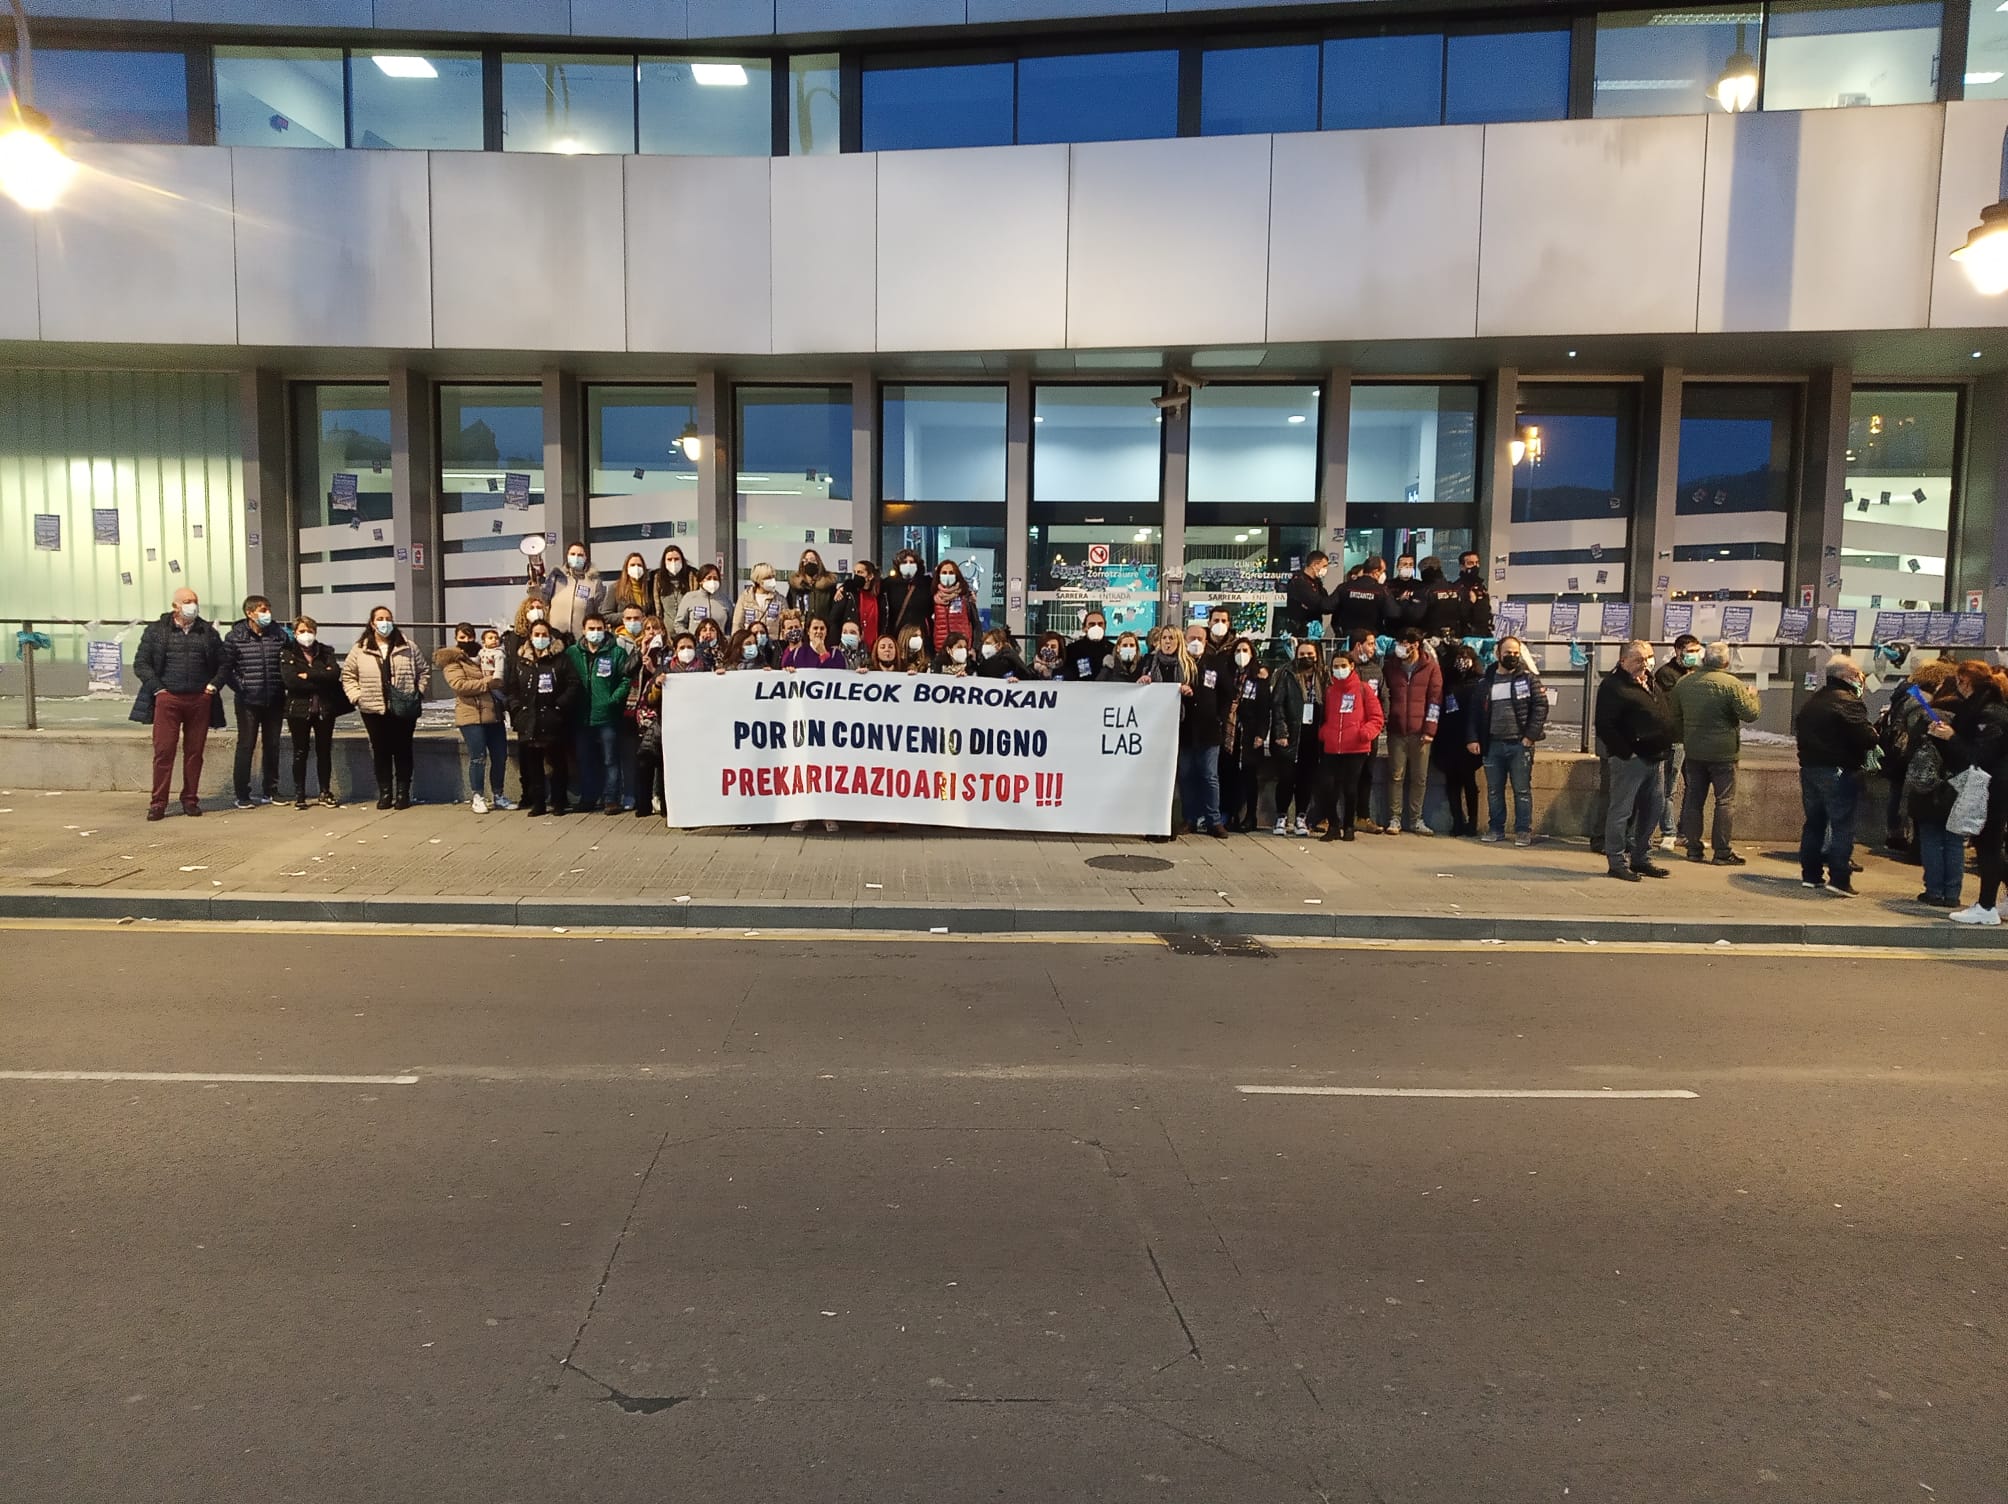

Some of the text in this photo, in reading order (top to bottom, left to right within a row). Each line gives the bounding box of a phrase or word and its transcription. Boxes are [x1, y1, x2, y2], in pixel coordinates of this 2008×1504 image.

[754, 680, 1058, 709] LANGILEOK BORROKAN
[1103, 706, 1139, 728] ELA
[734, 719, 1048, 757] POR UN CONVENIO DIGNO
[1101, 732, 1143, 755] LAB
[722, 764, 956, 801] PREKARIZAZIOARI
